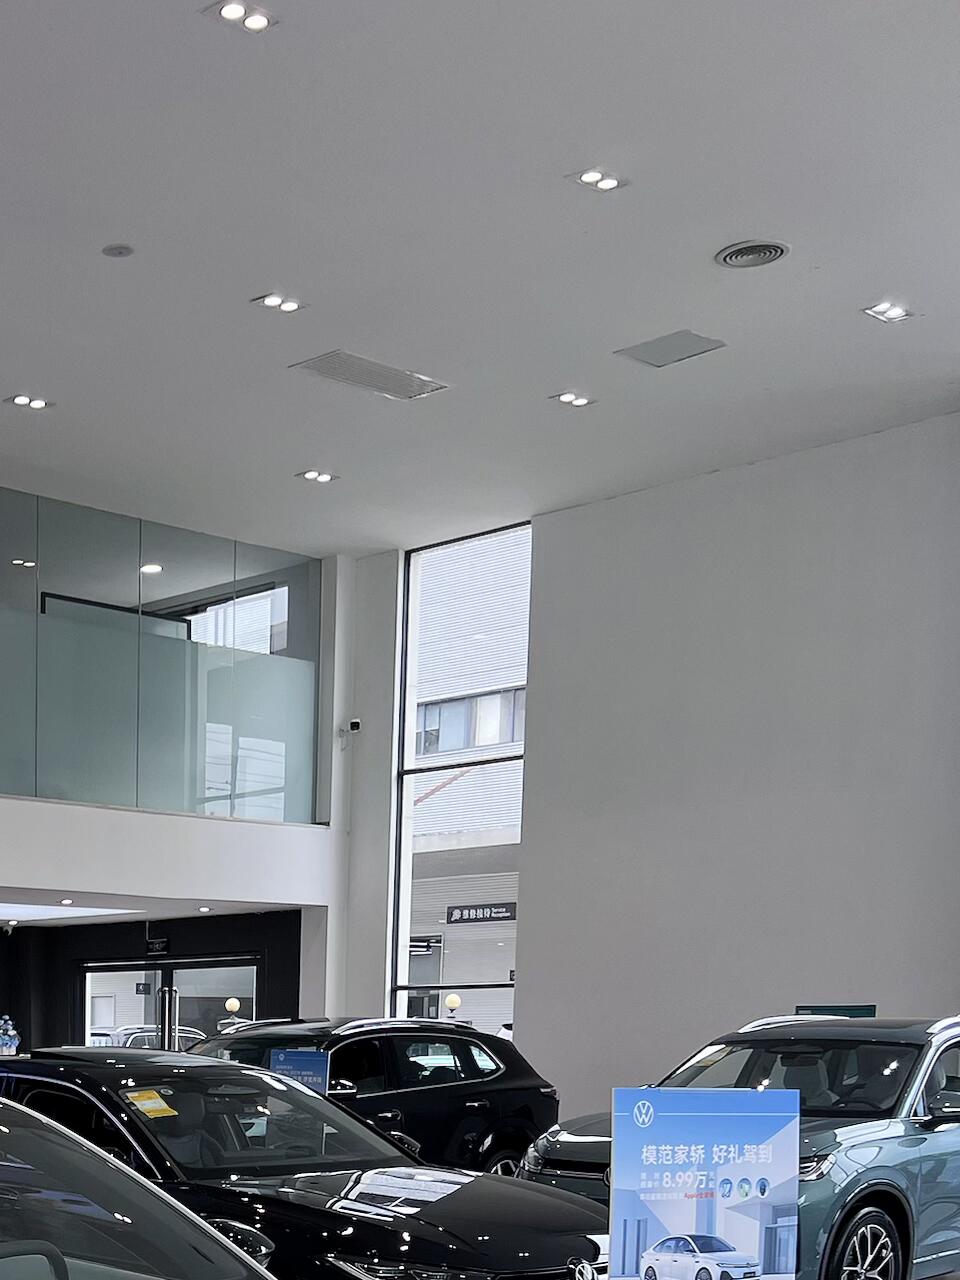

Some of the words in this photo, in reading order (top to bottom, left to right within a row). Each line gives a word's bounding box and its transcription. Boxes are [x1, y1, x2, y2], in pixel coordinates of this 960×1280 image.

[641, 1144, 705, 1165] 模范家轿
[711, 1143, 772, 1164] 好礼驾到
[662, 1171, 707, 1188] 8.99万
